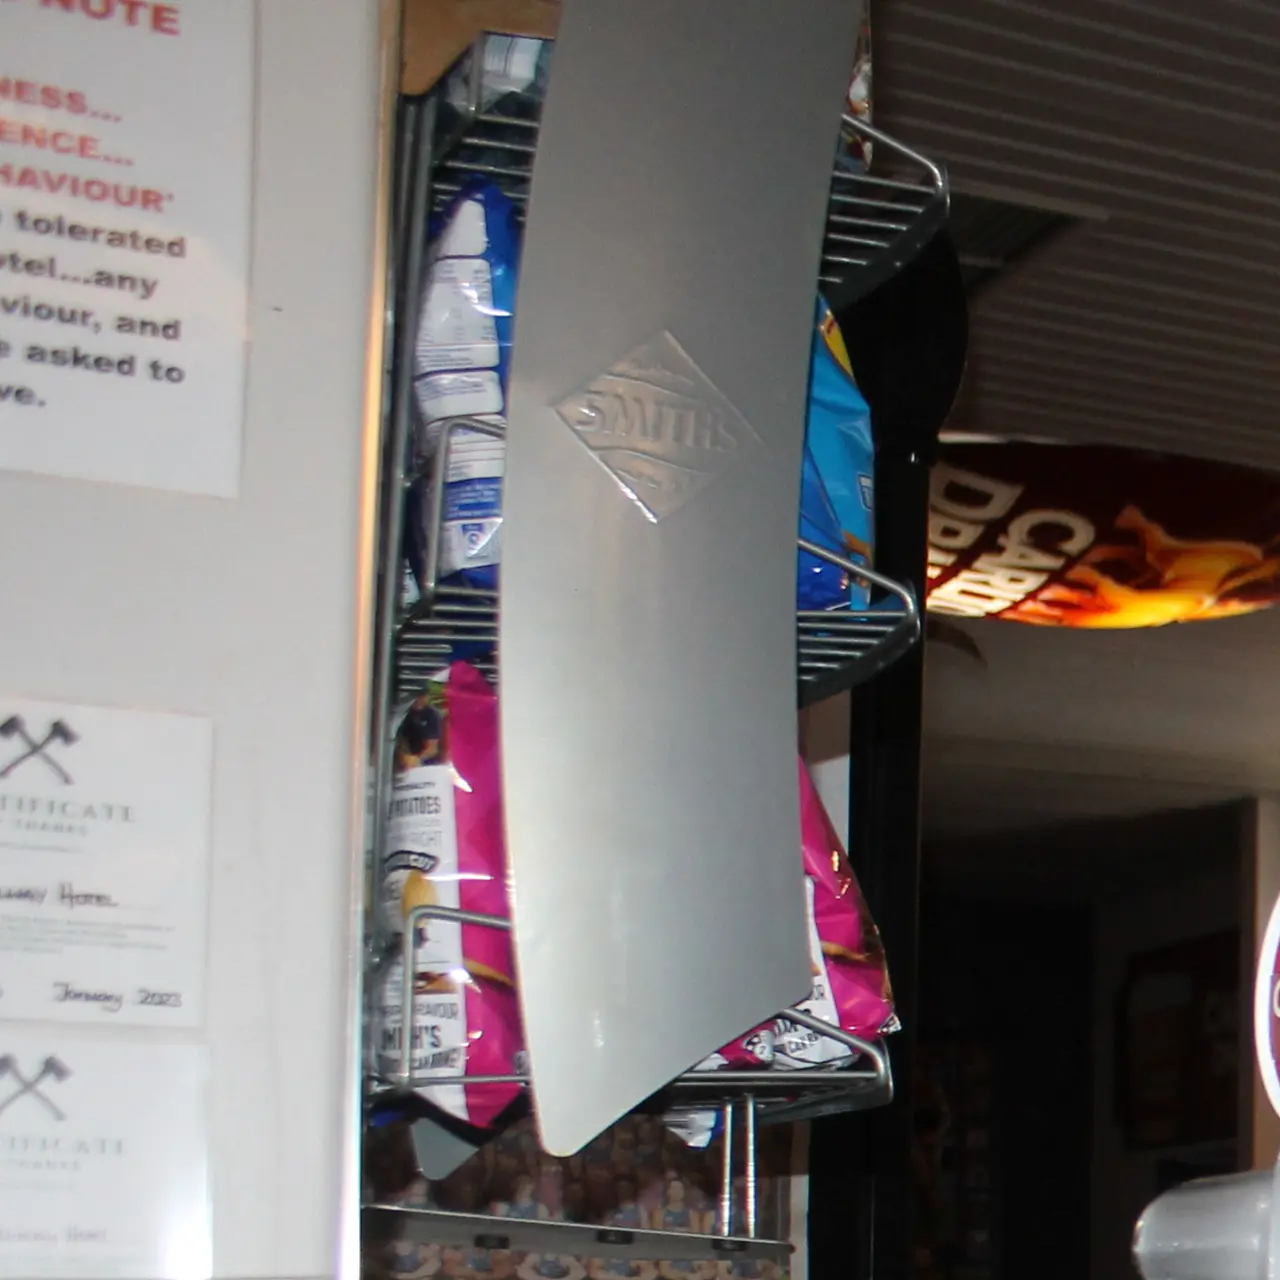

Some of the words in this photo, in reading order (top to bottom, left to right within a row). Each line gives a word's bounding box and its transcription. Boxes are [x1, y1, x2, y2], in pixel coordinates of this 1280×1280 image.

[16, 210, 187, 259] tolerated
[116, 315, 182, 341] and
[27, 344, 136, 376] asked
[150, 359, 186, 384] to
